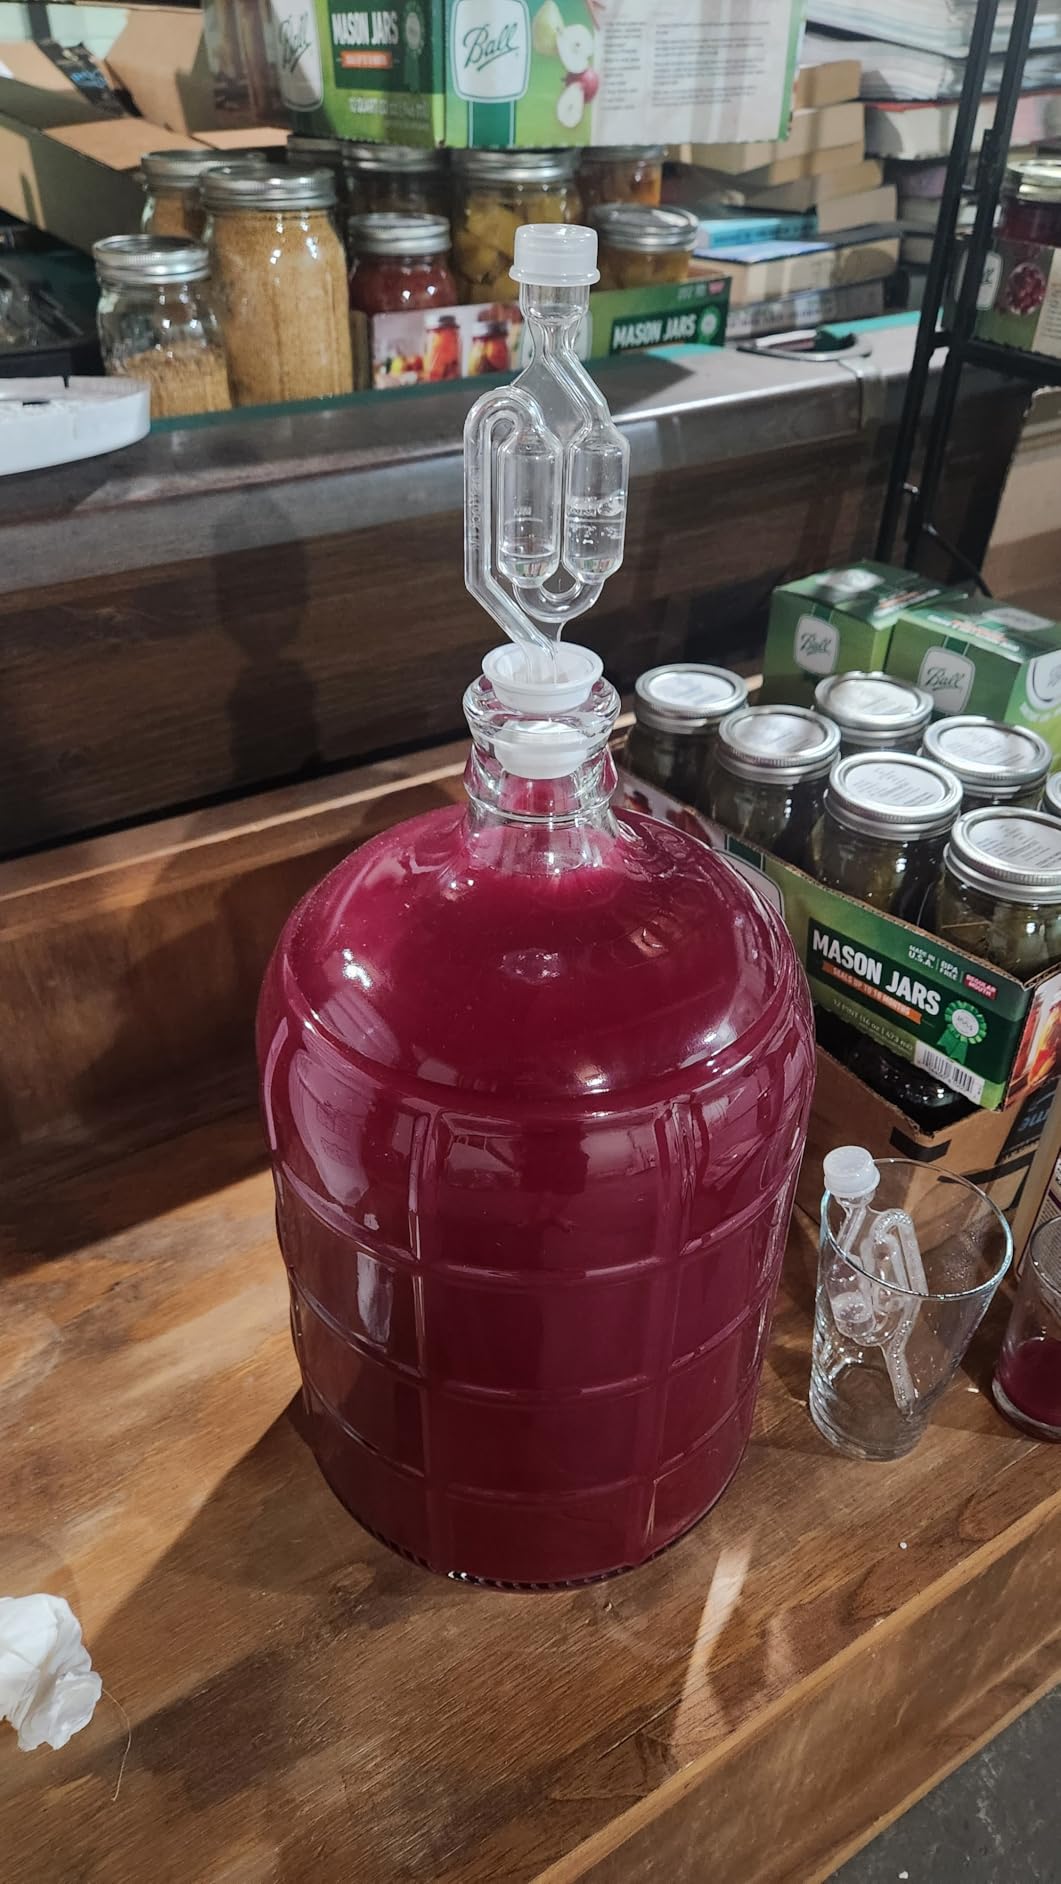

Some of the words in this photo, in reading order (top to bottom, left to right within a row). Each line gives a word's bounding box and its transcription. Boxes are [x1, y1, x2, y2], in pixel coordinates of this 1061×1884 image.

[332, 12, 370, 45] MASON
[371, 11, 399, 44] JARS
[463, 22, 520, 71] Ball
[613, 320, 663, 350] MASON
[662, 313, 697, 341] JARS
[800, 632, 833, 657] Ball
[925, 666, 966, 693] Ball
[908, 944, 928, 958] MADE
[908, 950, 934, 969] U.S.A.
[813, 929, 882, 985] MASON
[885, 971, 941, 1016] JARS
[939, 968, 958, 981] FREE
[940, 960, 959, 975] BPA
